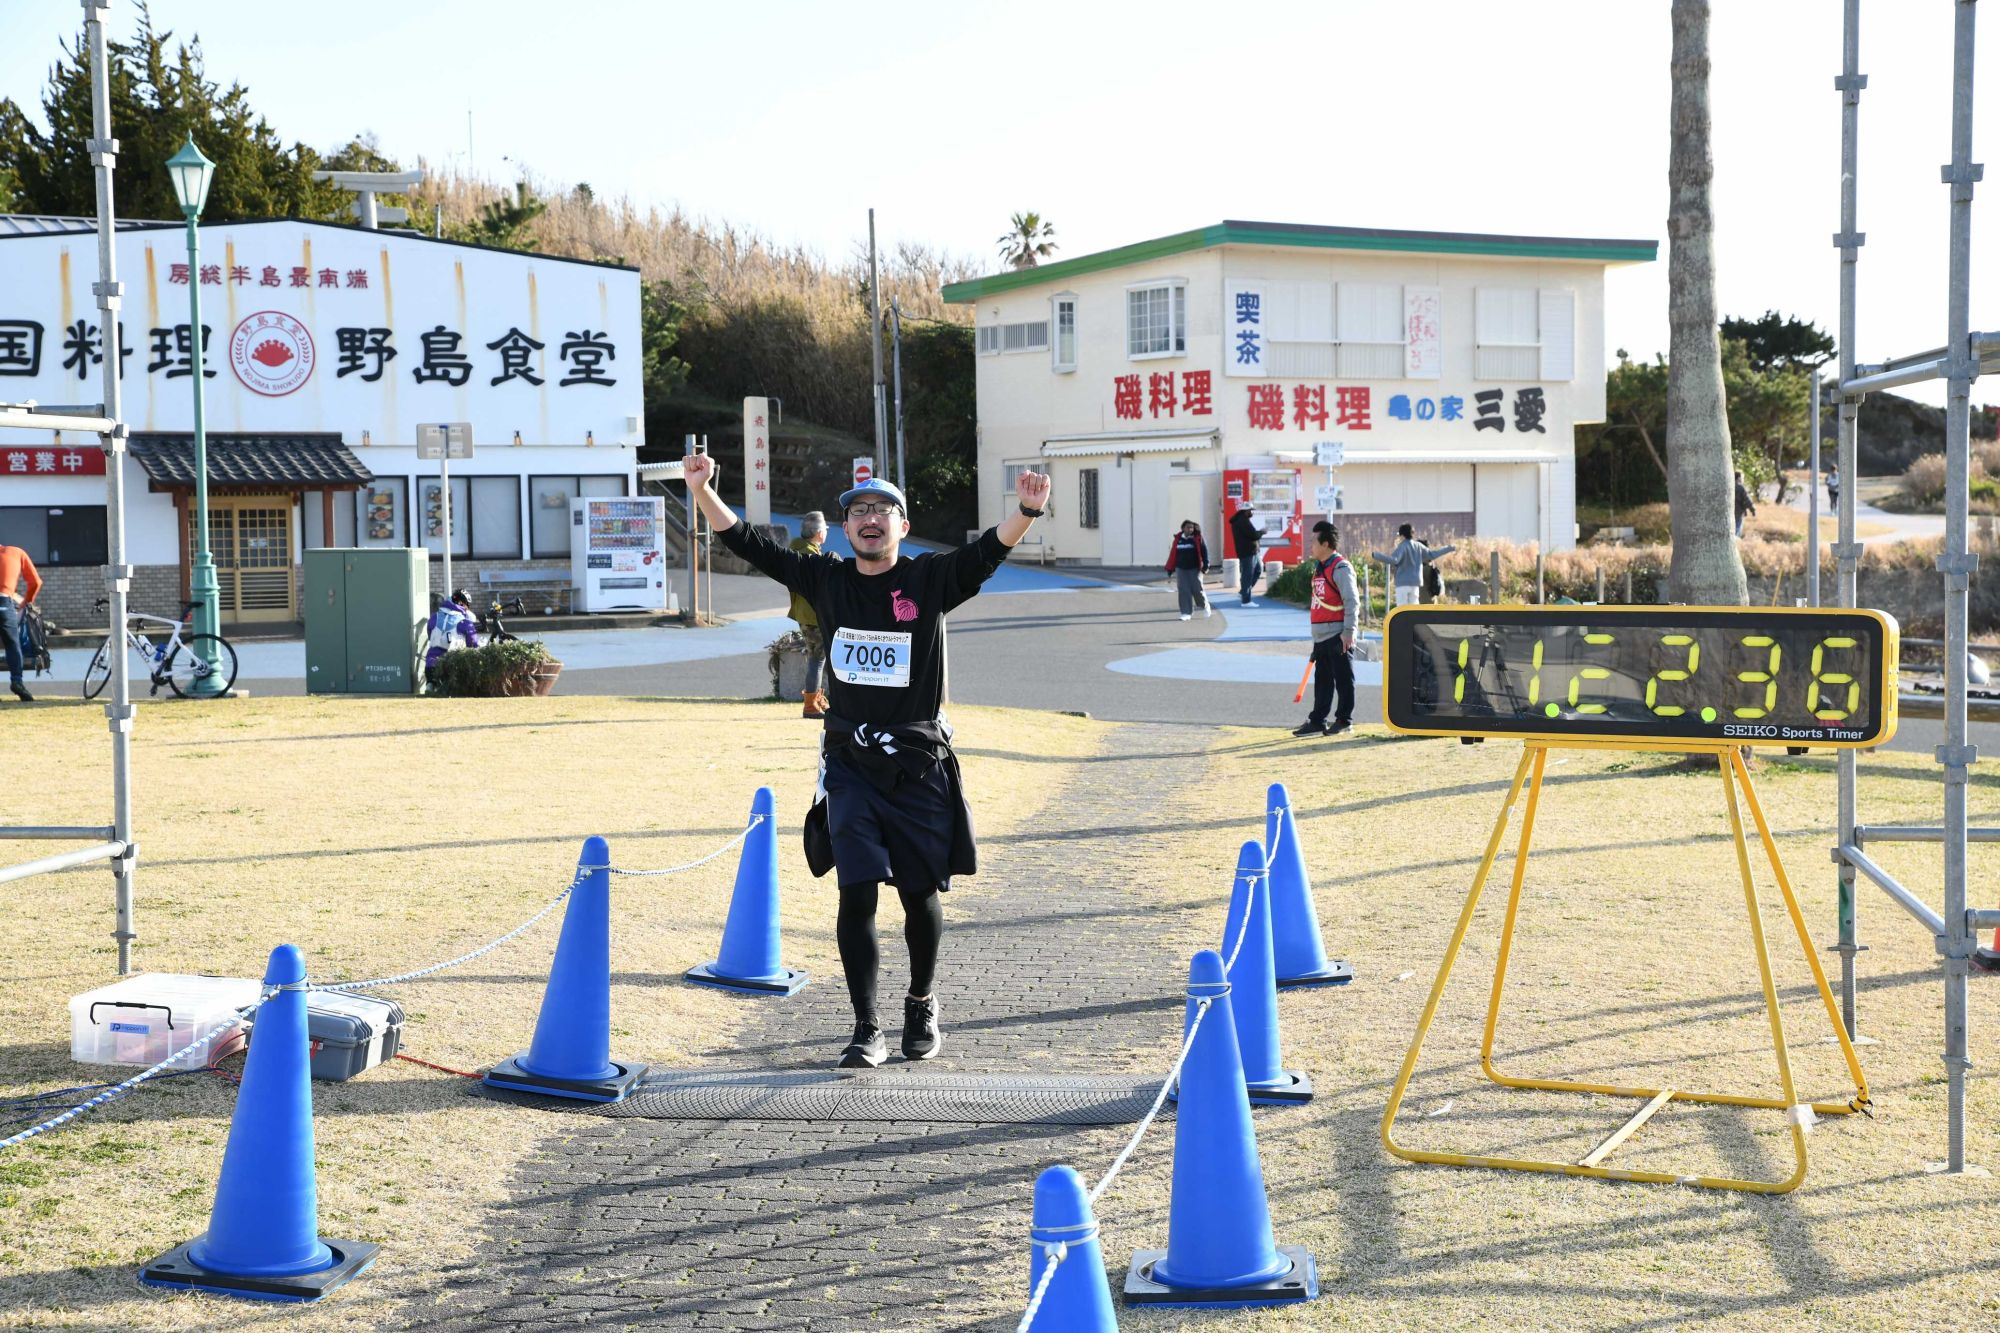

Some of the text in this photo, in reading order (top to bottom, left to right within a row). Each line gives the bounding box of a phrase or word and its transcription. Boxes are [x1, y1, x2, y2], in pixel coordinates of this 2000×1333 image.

[168, 263, 369, 289] 房総半島最南端
[242, 315, 302, 337] 野島食堂
[1236, 291, 1260, 364] 喫茶
[336, 325, 617, 387] 野島食堂
[243, 369, 305, 391] NOJIMA SHOKUDO
[1114, 369, 1213, 420] 磯料理
[1248, 384, 1547, 434] 磯料理 亀の家 三愛
[8, 452, 83, 472] 営業中
[844, 645, 895, 667] 7006
[1723, 724, 1864, 740] SEIKO Sports Timer
